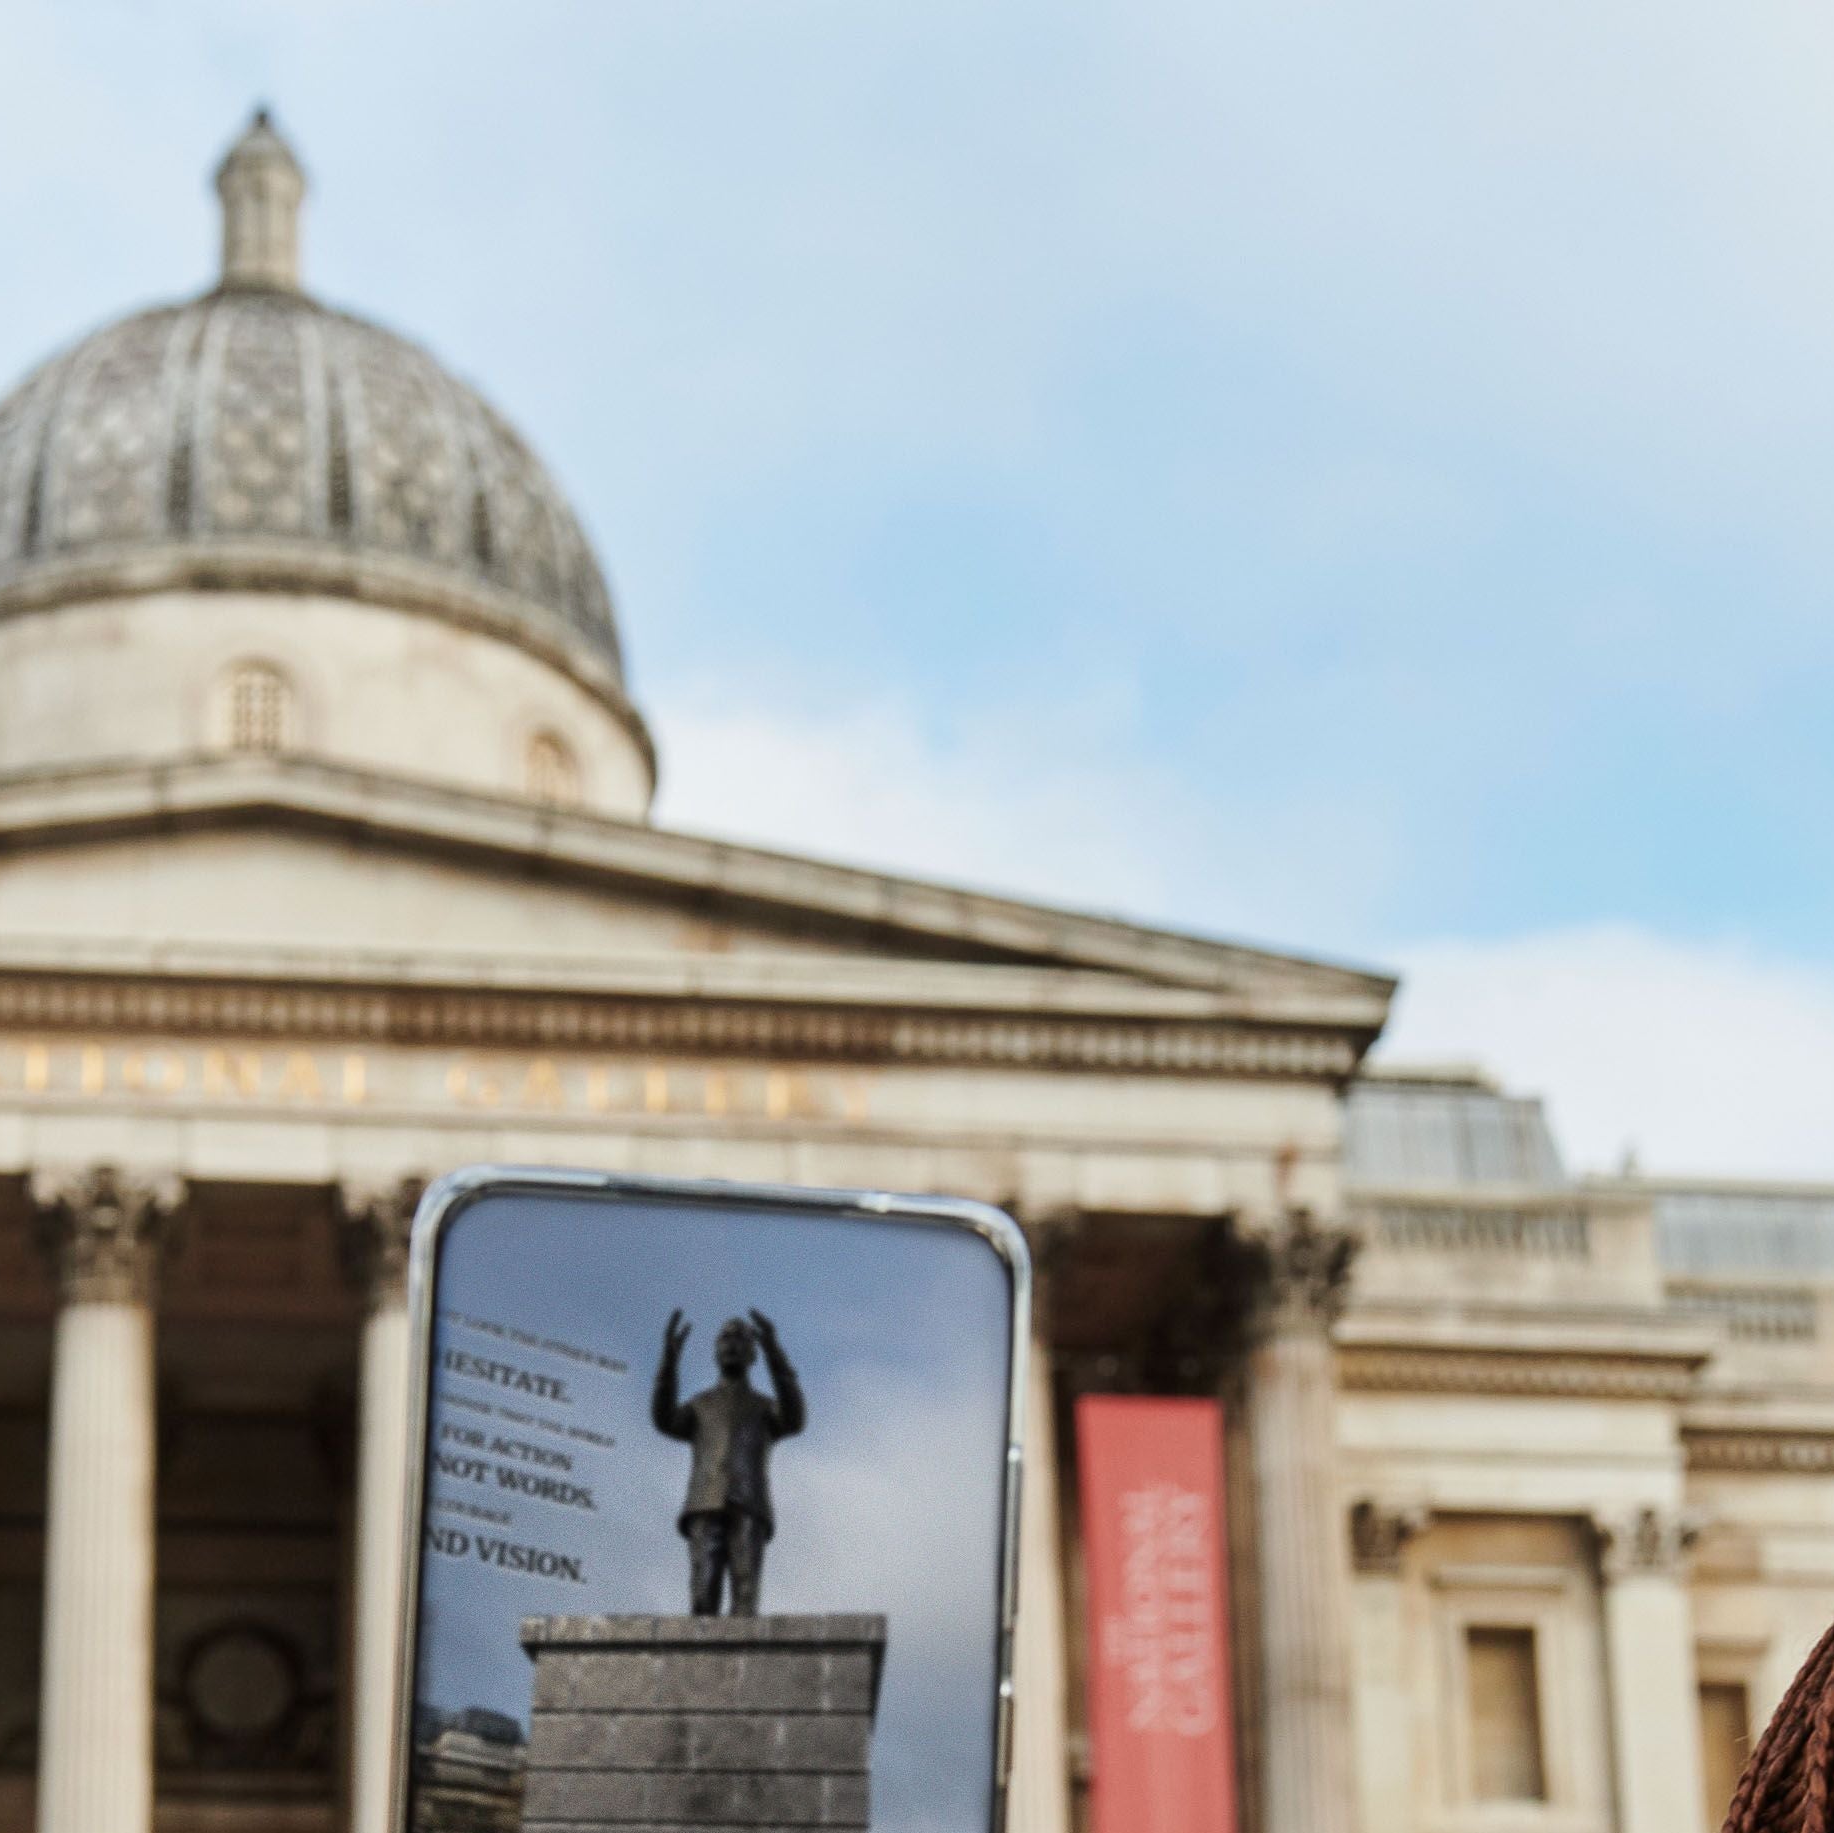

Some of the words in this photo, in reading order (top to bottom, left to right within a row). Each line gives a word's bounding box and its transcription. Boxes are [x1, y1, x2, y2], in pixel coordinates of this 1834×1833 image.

[442, 1422, 486, 1447] FOR
[489, 1435, 574, 1472] ACTION
[430, 1450, 489, 1484] NOT
[495, 1466, 599, 1512] WORDS.
[475, 1534, 588, 1585] VISION.
